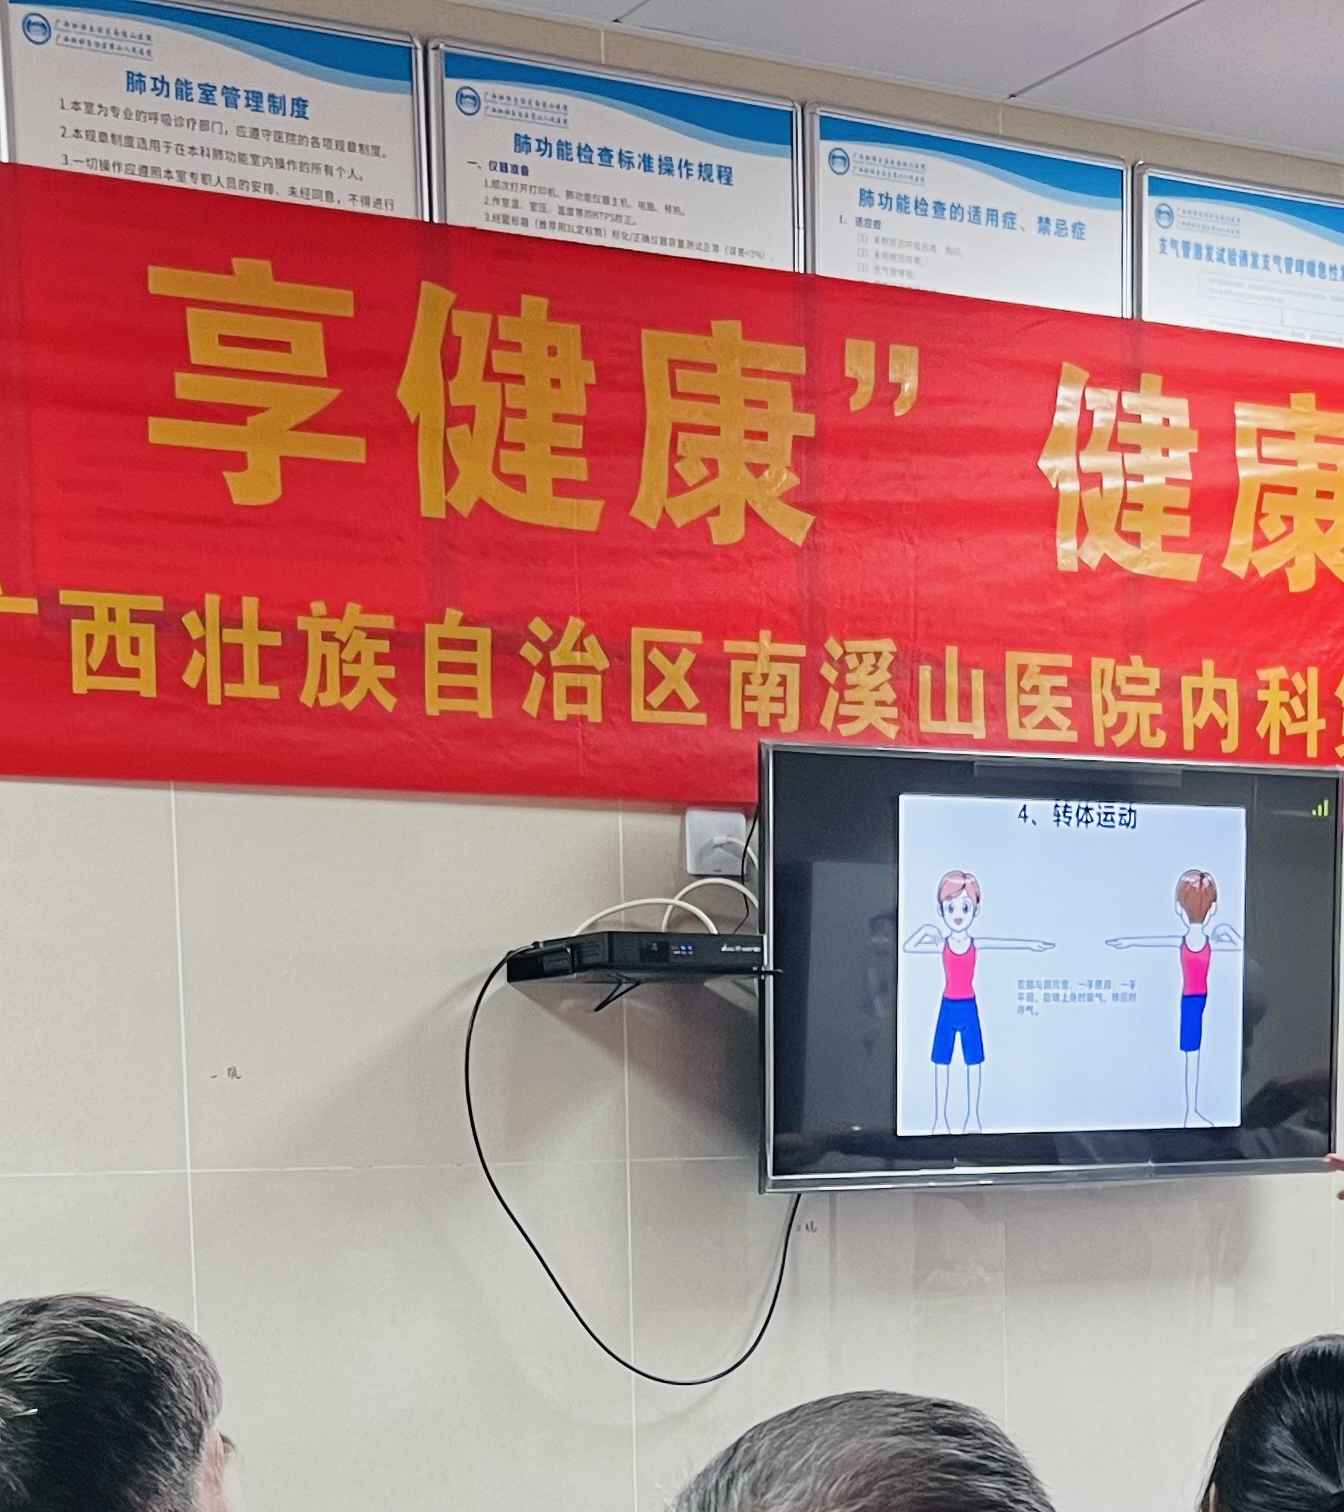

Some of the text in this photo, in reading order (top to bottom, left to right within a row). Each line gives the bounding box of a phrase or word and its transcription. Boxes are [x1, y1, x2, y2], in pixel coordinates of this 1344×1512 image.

[125, 69, 310, 120] 肺功能室管理制度
[513, 132, 735, 186] 肺功能检查标准操作规程
[858, 188, 1087, 241] 肺功能检查的适用症、禁忌症
